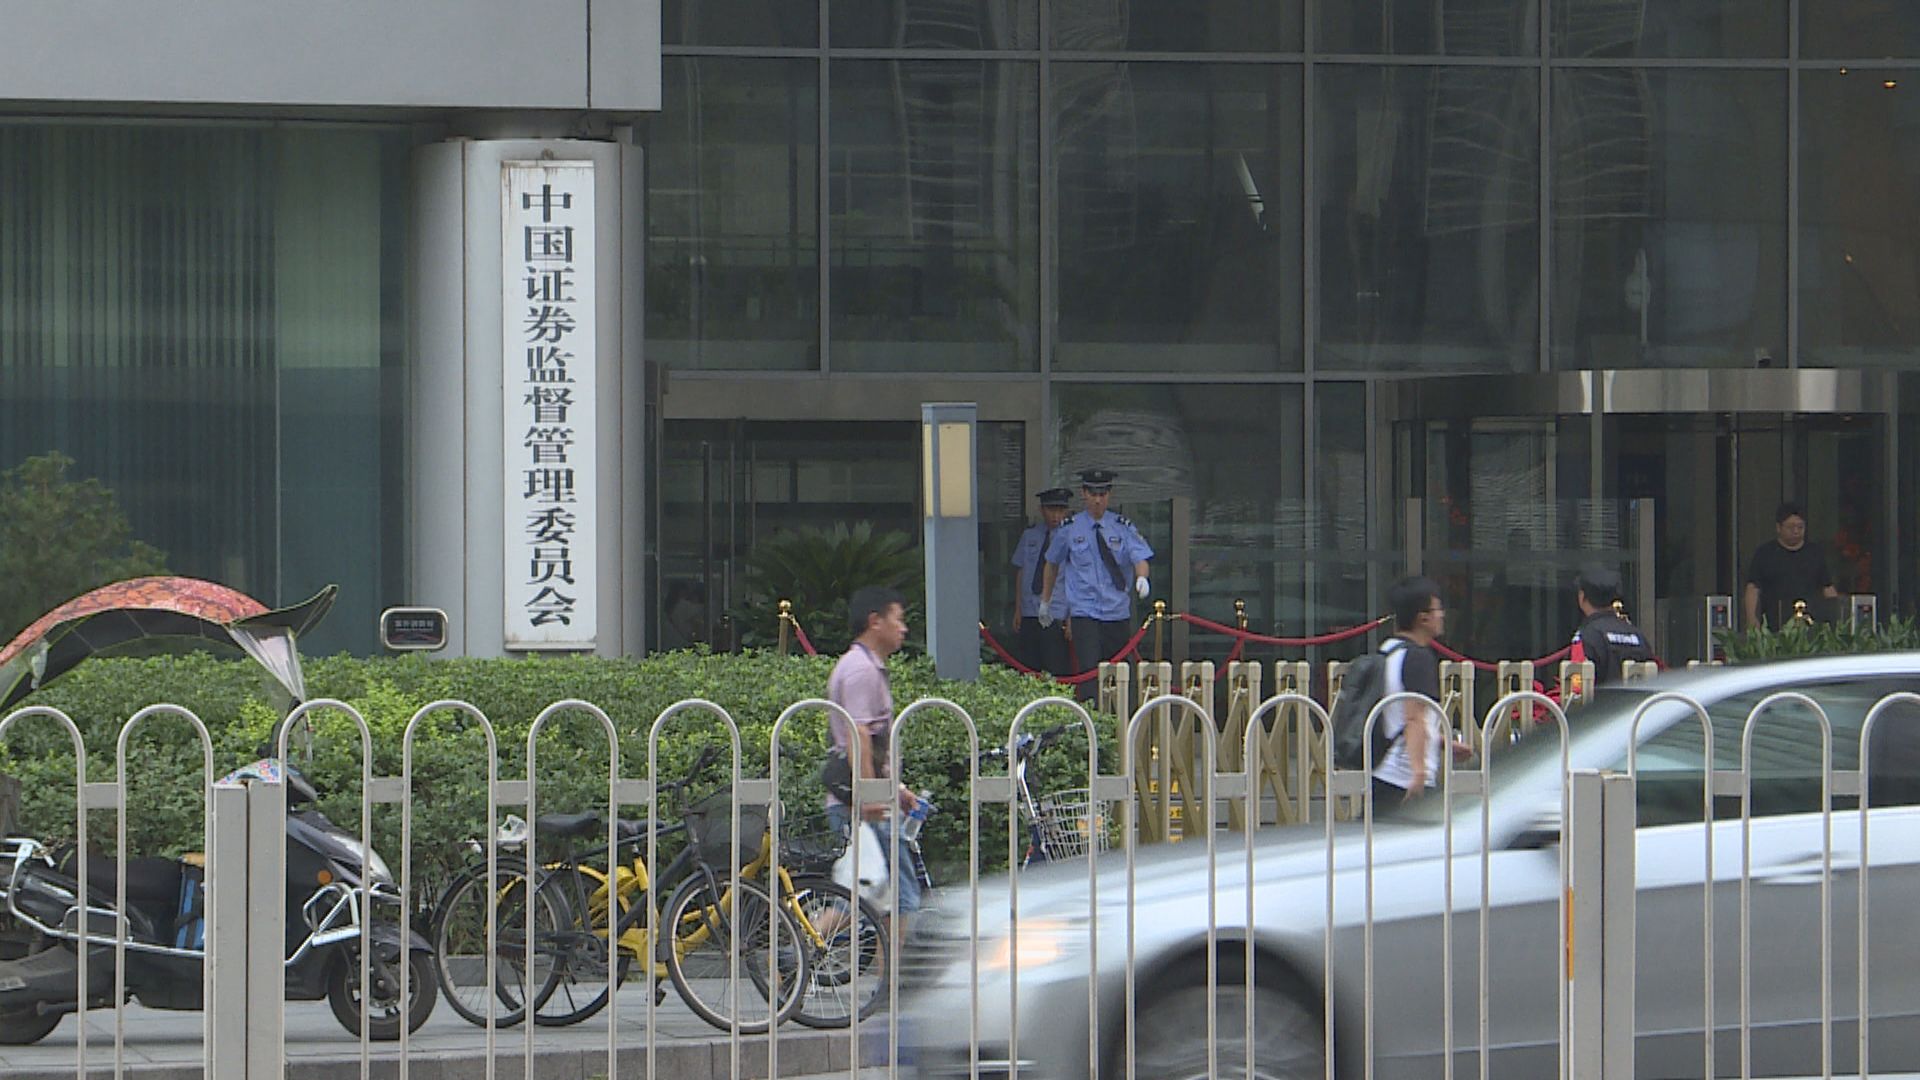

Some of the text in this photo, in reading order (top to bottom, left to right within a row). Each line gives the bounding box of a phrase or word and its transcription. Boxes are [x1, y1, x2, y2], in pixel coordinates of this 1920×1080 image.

[522, 184, 577, 627] 中国证券监督管理委员会
